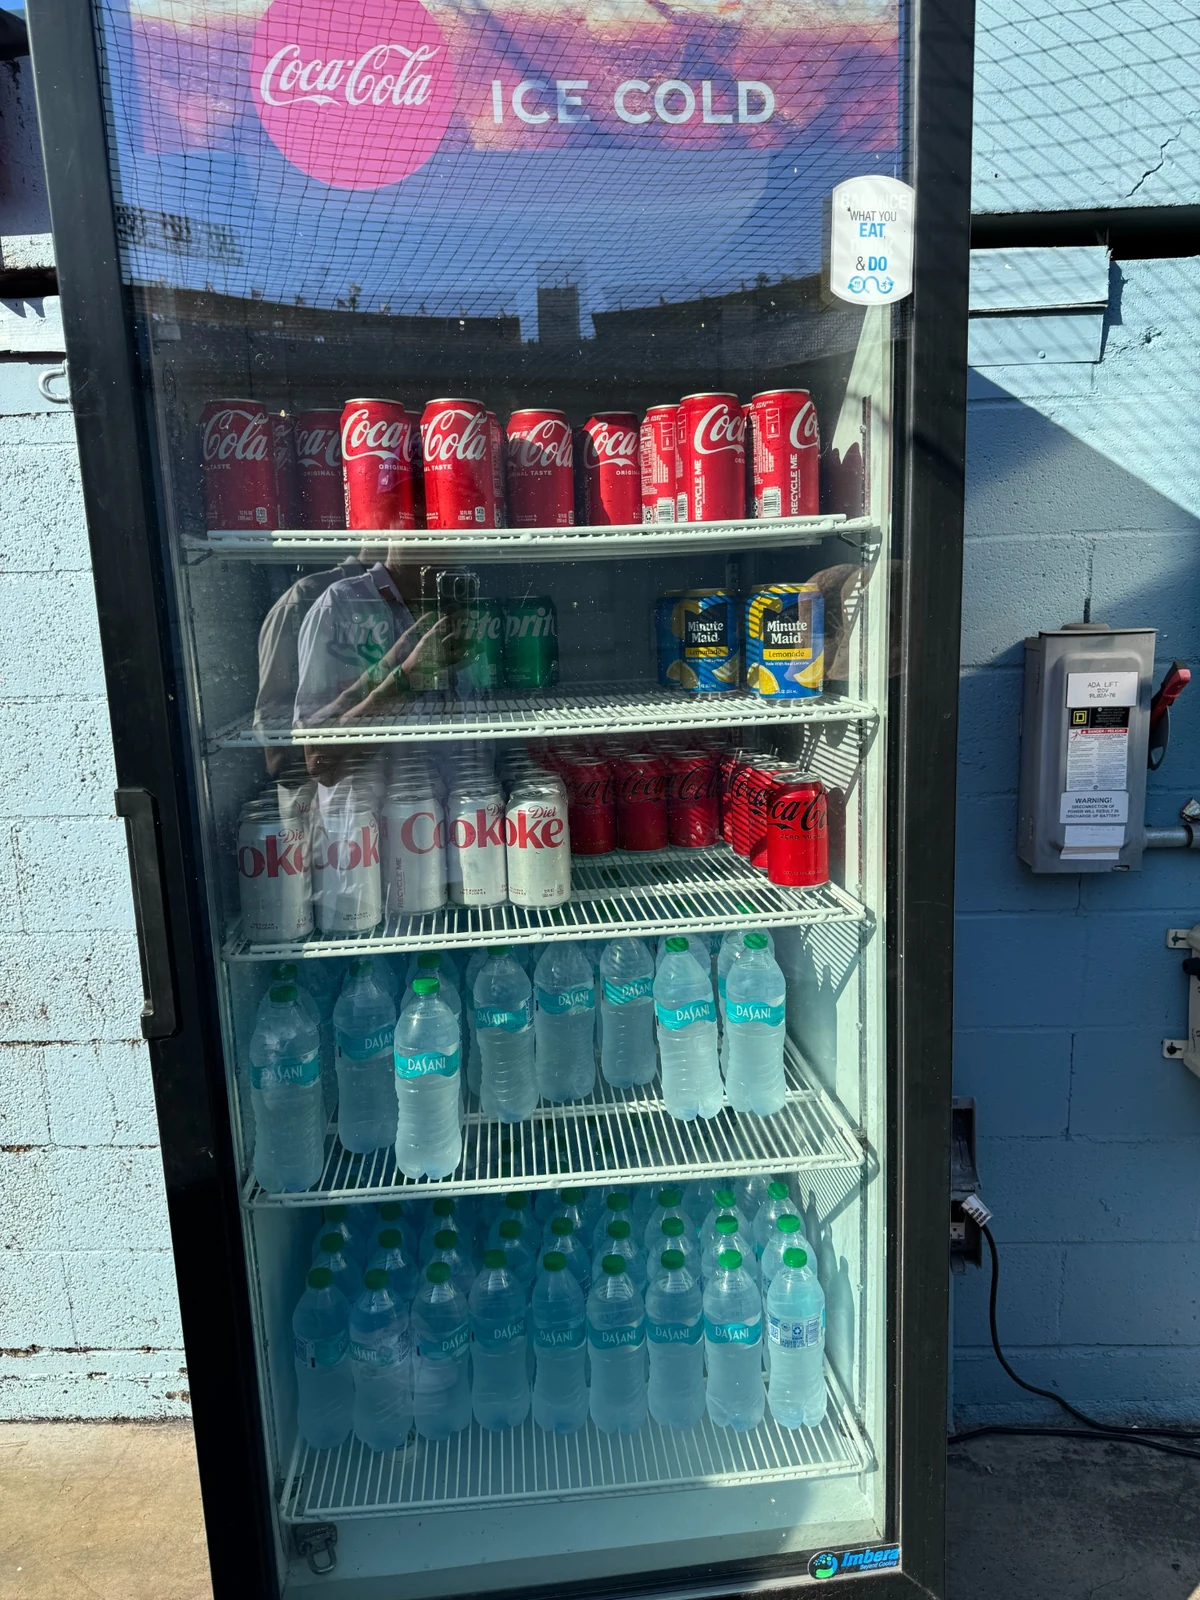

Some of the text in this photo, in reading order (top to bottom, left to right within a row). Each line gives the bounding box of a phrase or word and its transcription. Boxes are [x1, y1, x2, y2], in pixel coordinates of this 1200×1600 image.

[260, 43, 441, 108] Coca-Cola
[492, 79, 776, 125] ICE COLD
[839, 193, 909, 211] BANCE
[849, 210, 897, 222] WHAT YOU
[855, 256, 888, 271] & DO
[342, 465, 347, 481] ME
[694, 459, 703, 521] RECYCLE ME
[790, 453, 798, 514] RECYCLE ME
[452, 609, 501, 640] rite
[688, 620, 724, 632] Minute
[766, 620, 808, 632] Minute
[691, 632, 720, 643] Maid
[770, 632, 803, 645] Maid
[689, 647, 722, 656] Lemonade
[768, 650, 805, 658] Lemonade
[527, 804, 558, 819] Diet
[397, 857, 403, 871] ME
[621, 982, 652, 997] DASANI
[558, 991, 589, 1006] DASANI
[477, 1010, 508, 1026] DASANI
[675, 1004, 710, 1022] DASANI
[736, 1004, 771, 1021] DASANI
[364, 1031, 394, 1050] DASAN
[262, 1064, 303, 1083] DASANI
[407, 1056, 446, 1075] DASANI
[442, 1331, 468, 1351] DASAN
[540, 1329, 573, 1346] DASANI
[602, 1329, 636, 1346] DASANI
[655, 1326, 690, 1342] DASANI
[715, 1326, 749, 1341] DASANI
[841, 1547, 899, 1567] Imbera
[860, 1560, 898, 1570] Beyond Cooling
